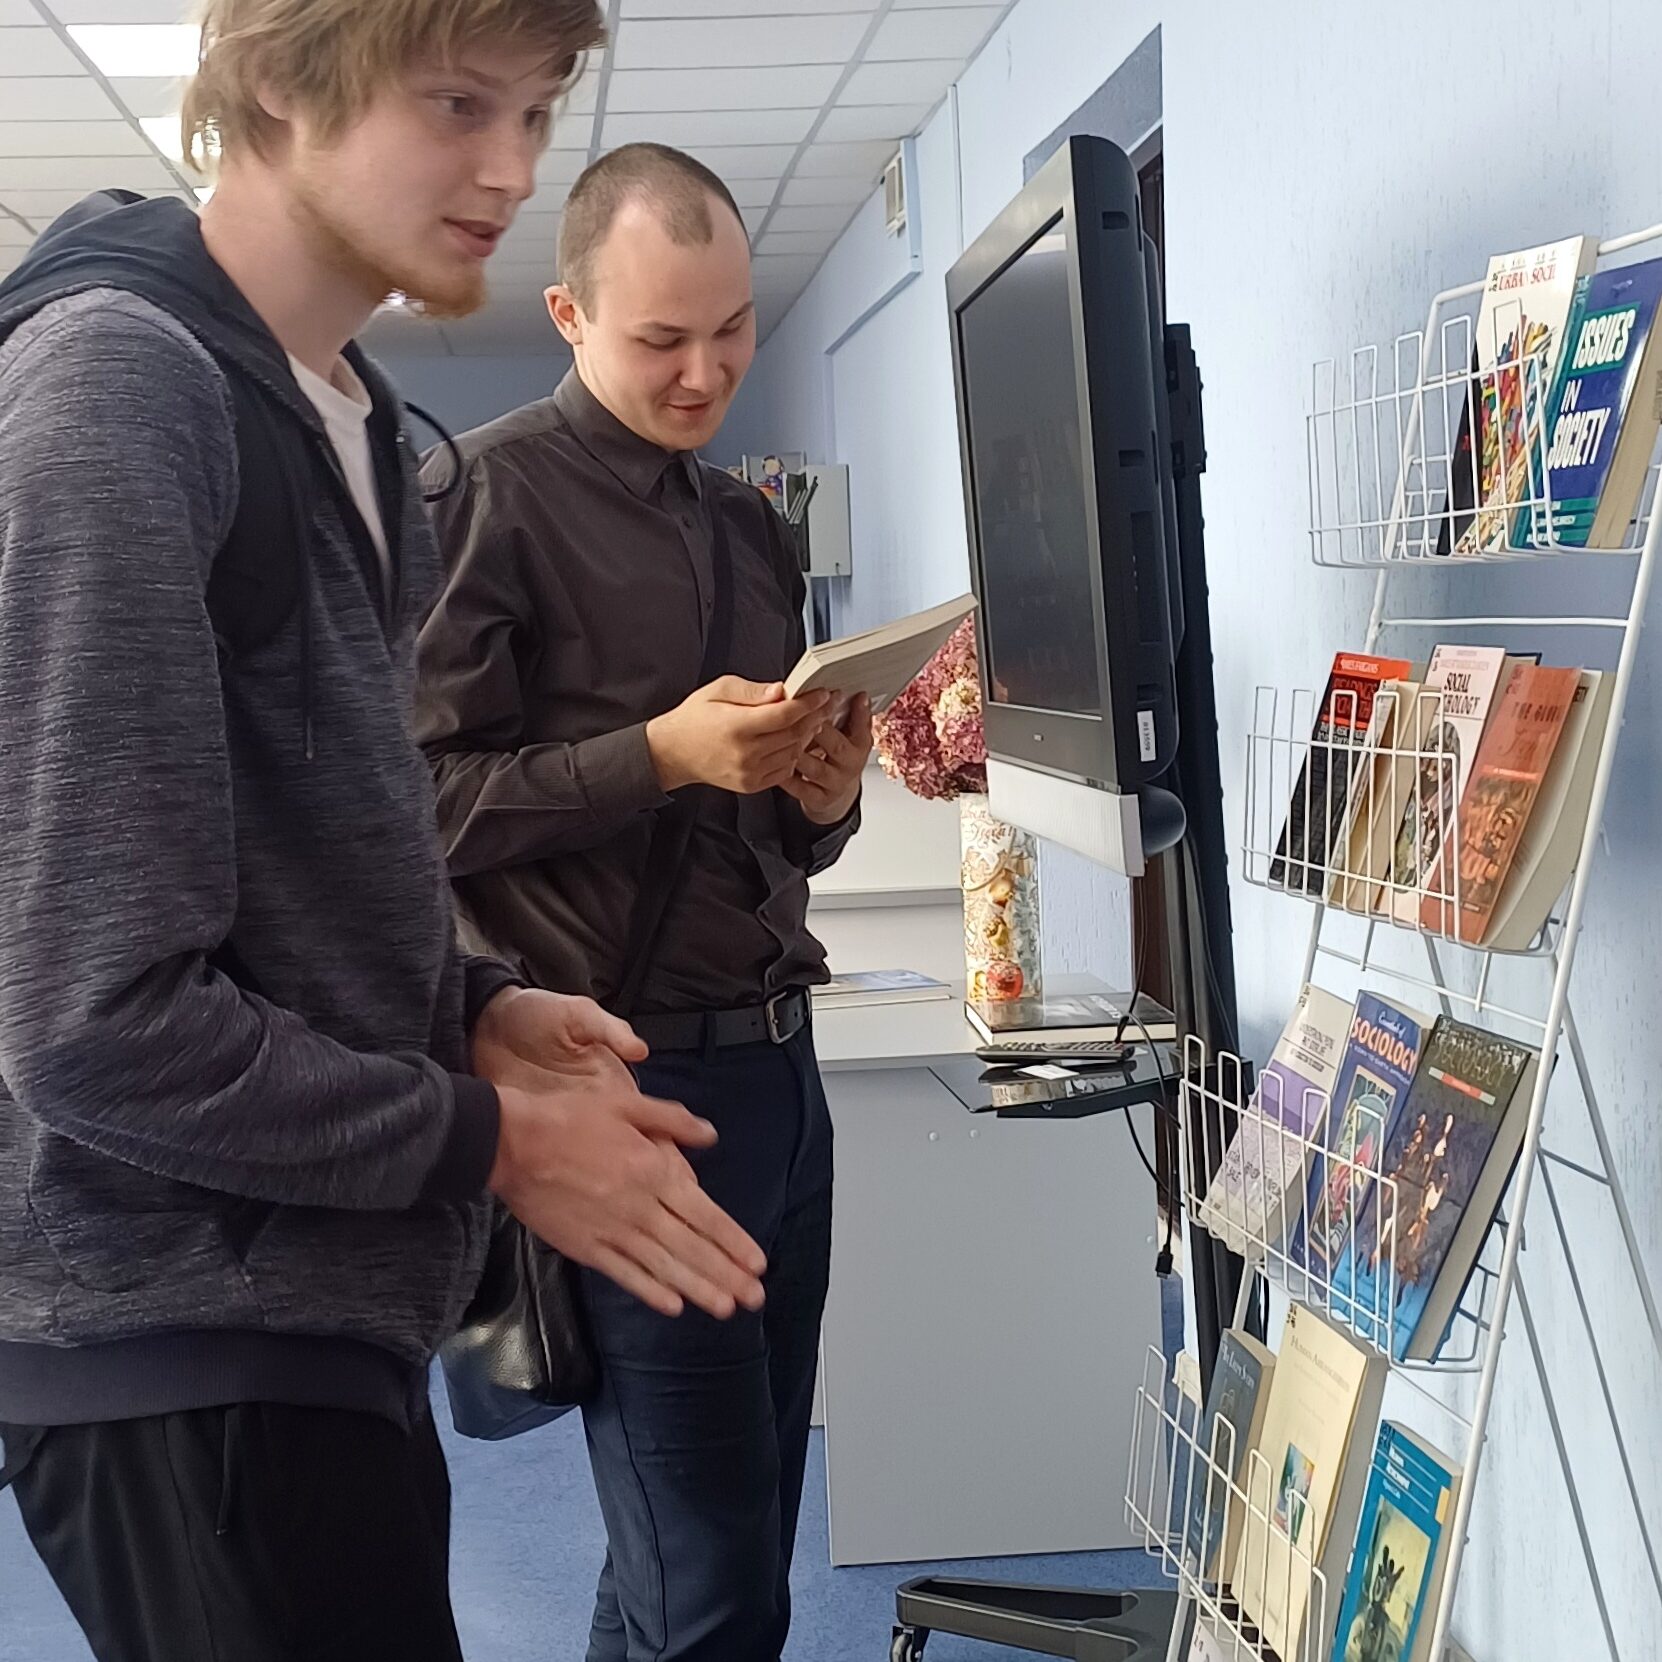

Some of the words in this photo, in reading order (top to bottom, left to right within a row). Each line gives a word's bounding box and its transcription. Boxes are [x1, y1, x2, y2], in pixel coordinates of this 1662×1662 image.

[1572, 309, 1636, 370] ISSUES
[1560, 379, 1582, 413] IN
[1548, 407, 1611, 471] SOCIETY
[1443, 672, 1471, 694] SOCIAL
[1351, 1016, 1418, 1075] SOCIOLOGY
